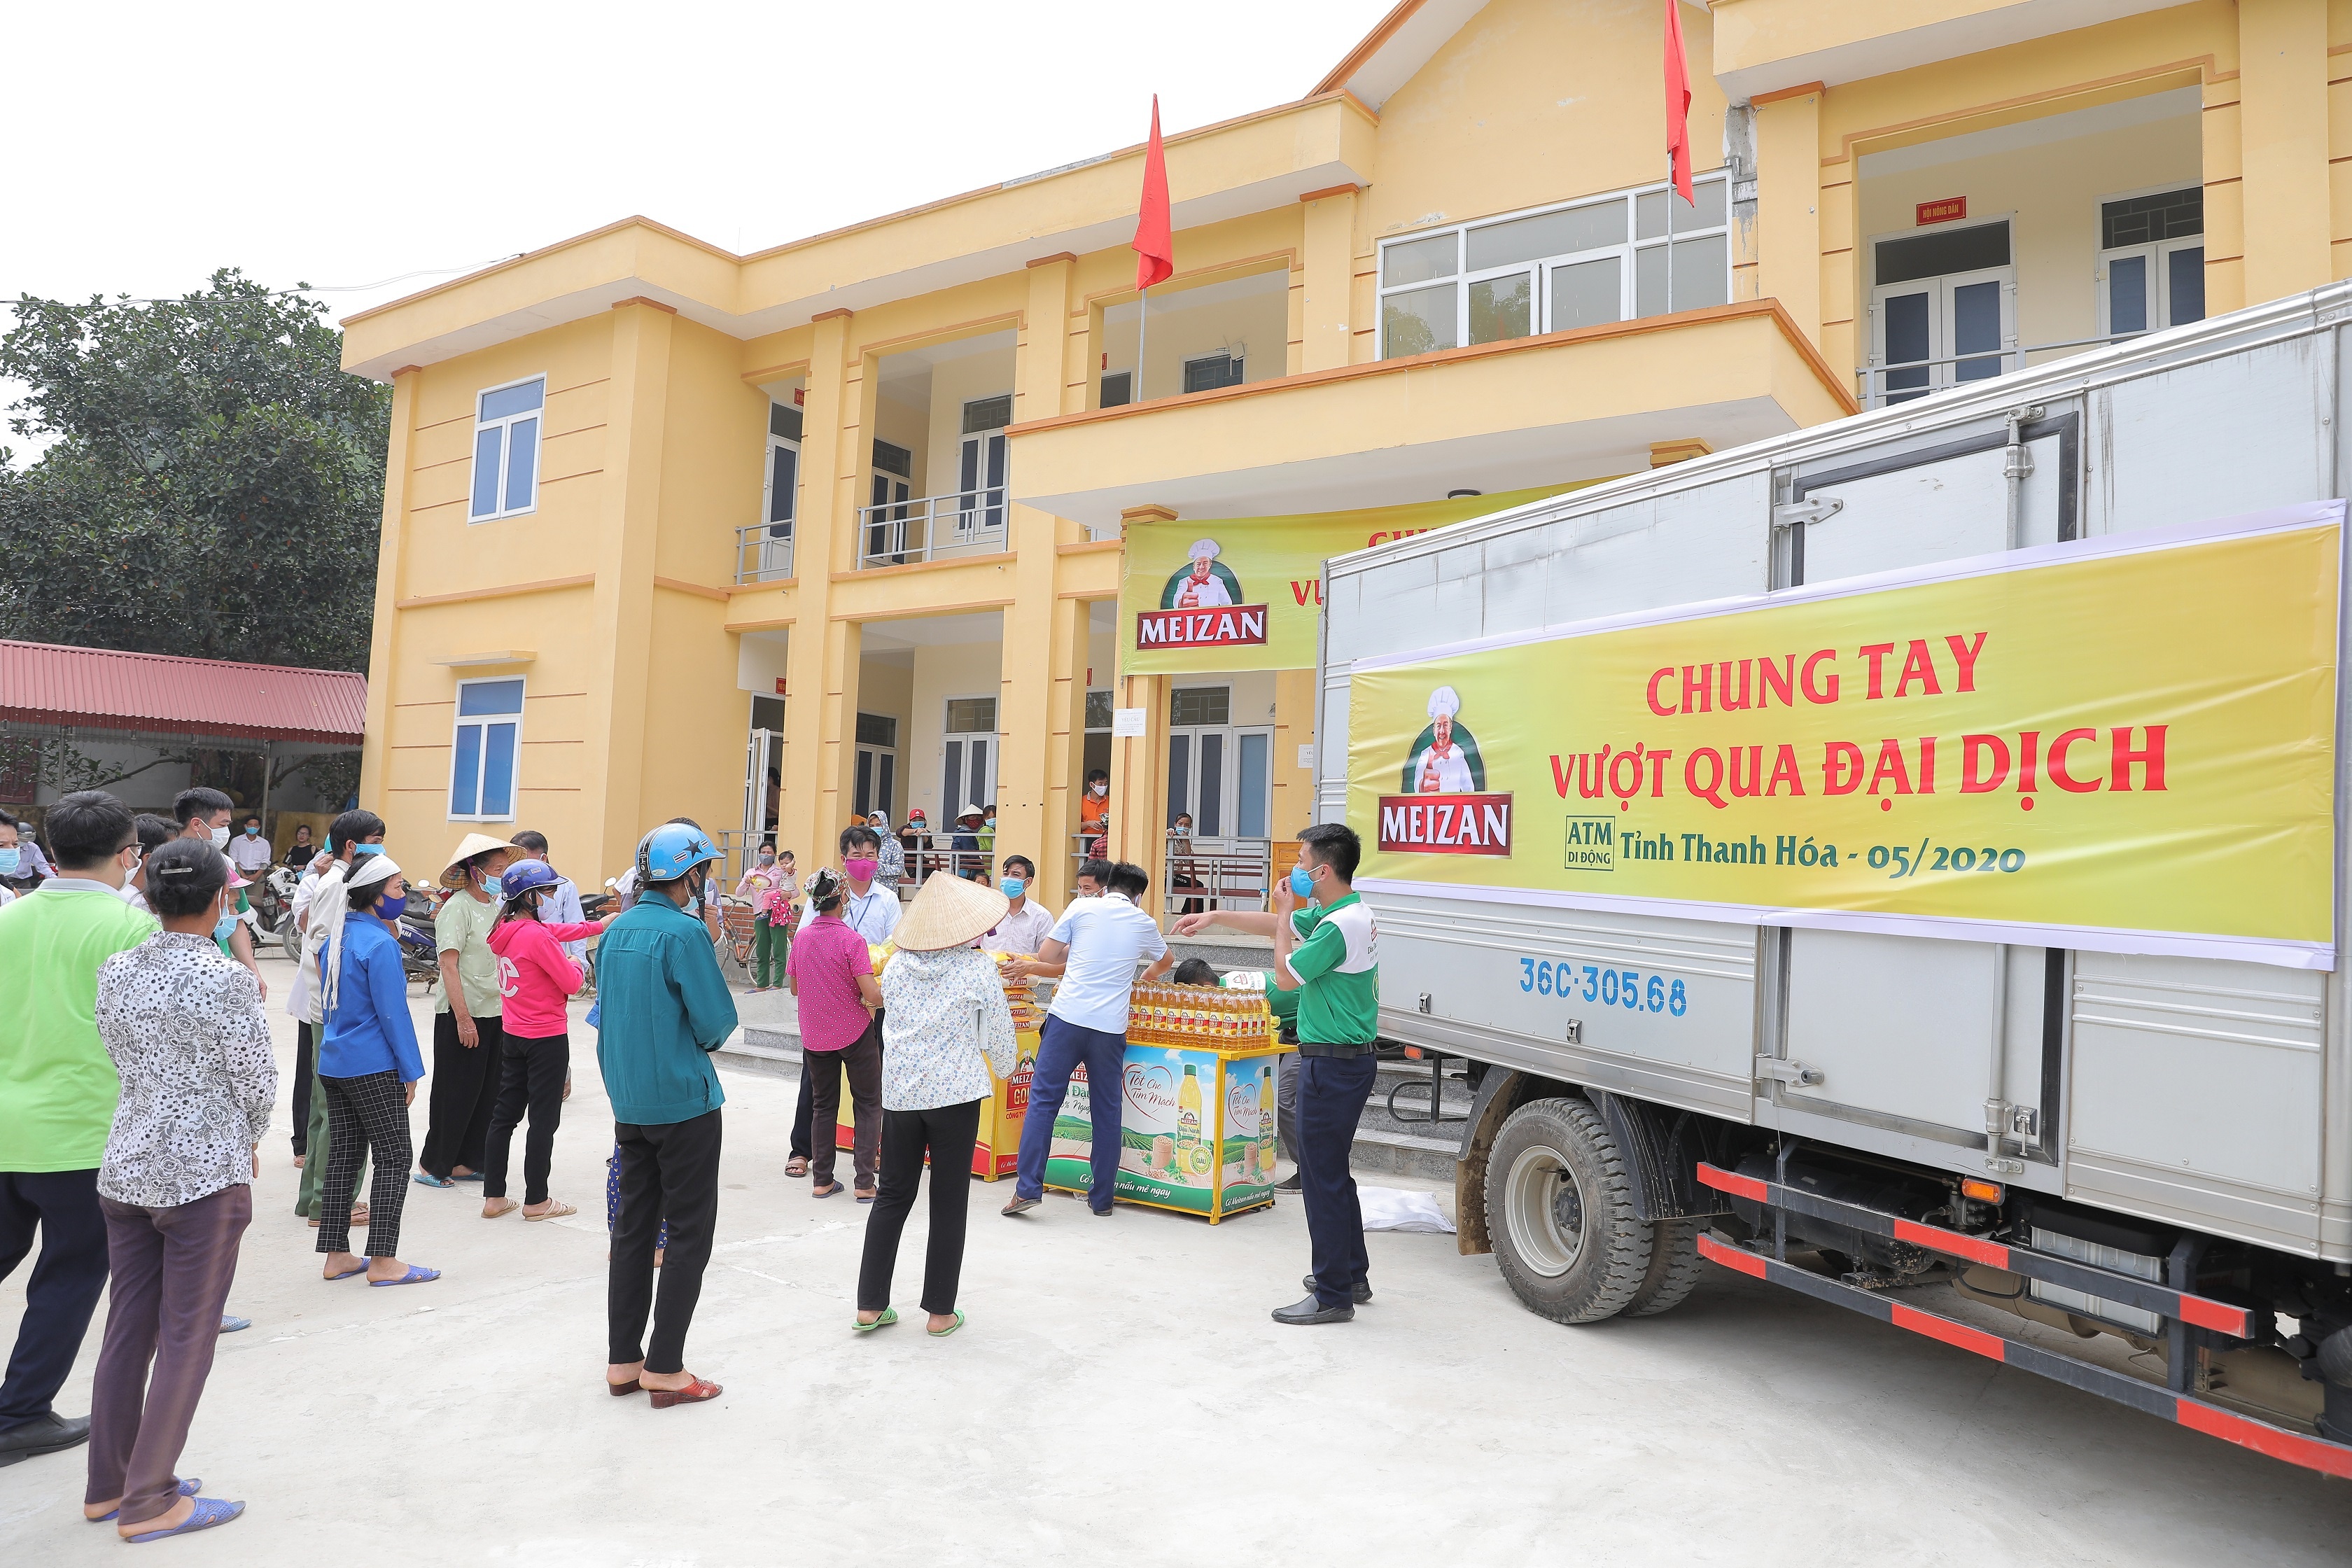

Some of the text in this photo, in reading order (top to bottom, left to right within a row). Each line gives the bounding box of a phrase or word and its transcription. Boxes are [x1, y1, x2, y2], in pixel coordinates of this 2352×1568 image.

[1923, 203, 1959, 220] HỘI NÔNG DÂN
[1139, 610, 1264, 644] MEIZAN
[1647, 631, 1989, 716] CHUNG TAY
[1549, 724, 2169, 812] VƯỢT QUA ĐẠI DỊCH
[1381, 802, 1509, 847] MEIZAN
[1567, 822, 1612, 846] ATM
[1568, 849, 1610, 867] DI ĐỘNG
[1620, 832, 1674, 862] Tỉnh
[1681, 833, 1770, 865] Thanh
[1774, 835, 1838, 868] Hóa
[1867, 838, 2026, 879] 05/2020
[401, 930, 412, 938] AHA
[1128, 1070, 1162, 1090] Tốt Cho
[1131, 1088, 1176, 1108] Tim Mạch
[1079, 1173, 1089, 1184] Có
[1119, 1180, 1135, 1191] nấu
[1136, 1184, 1150, 1193] mê
[1150, 1187, 1171, 1199] ngay
